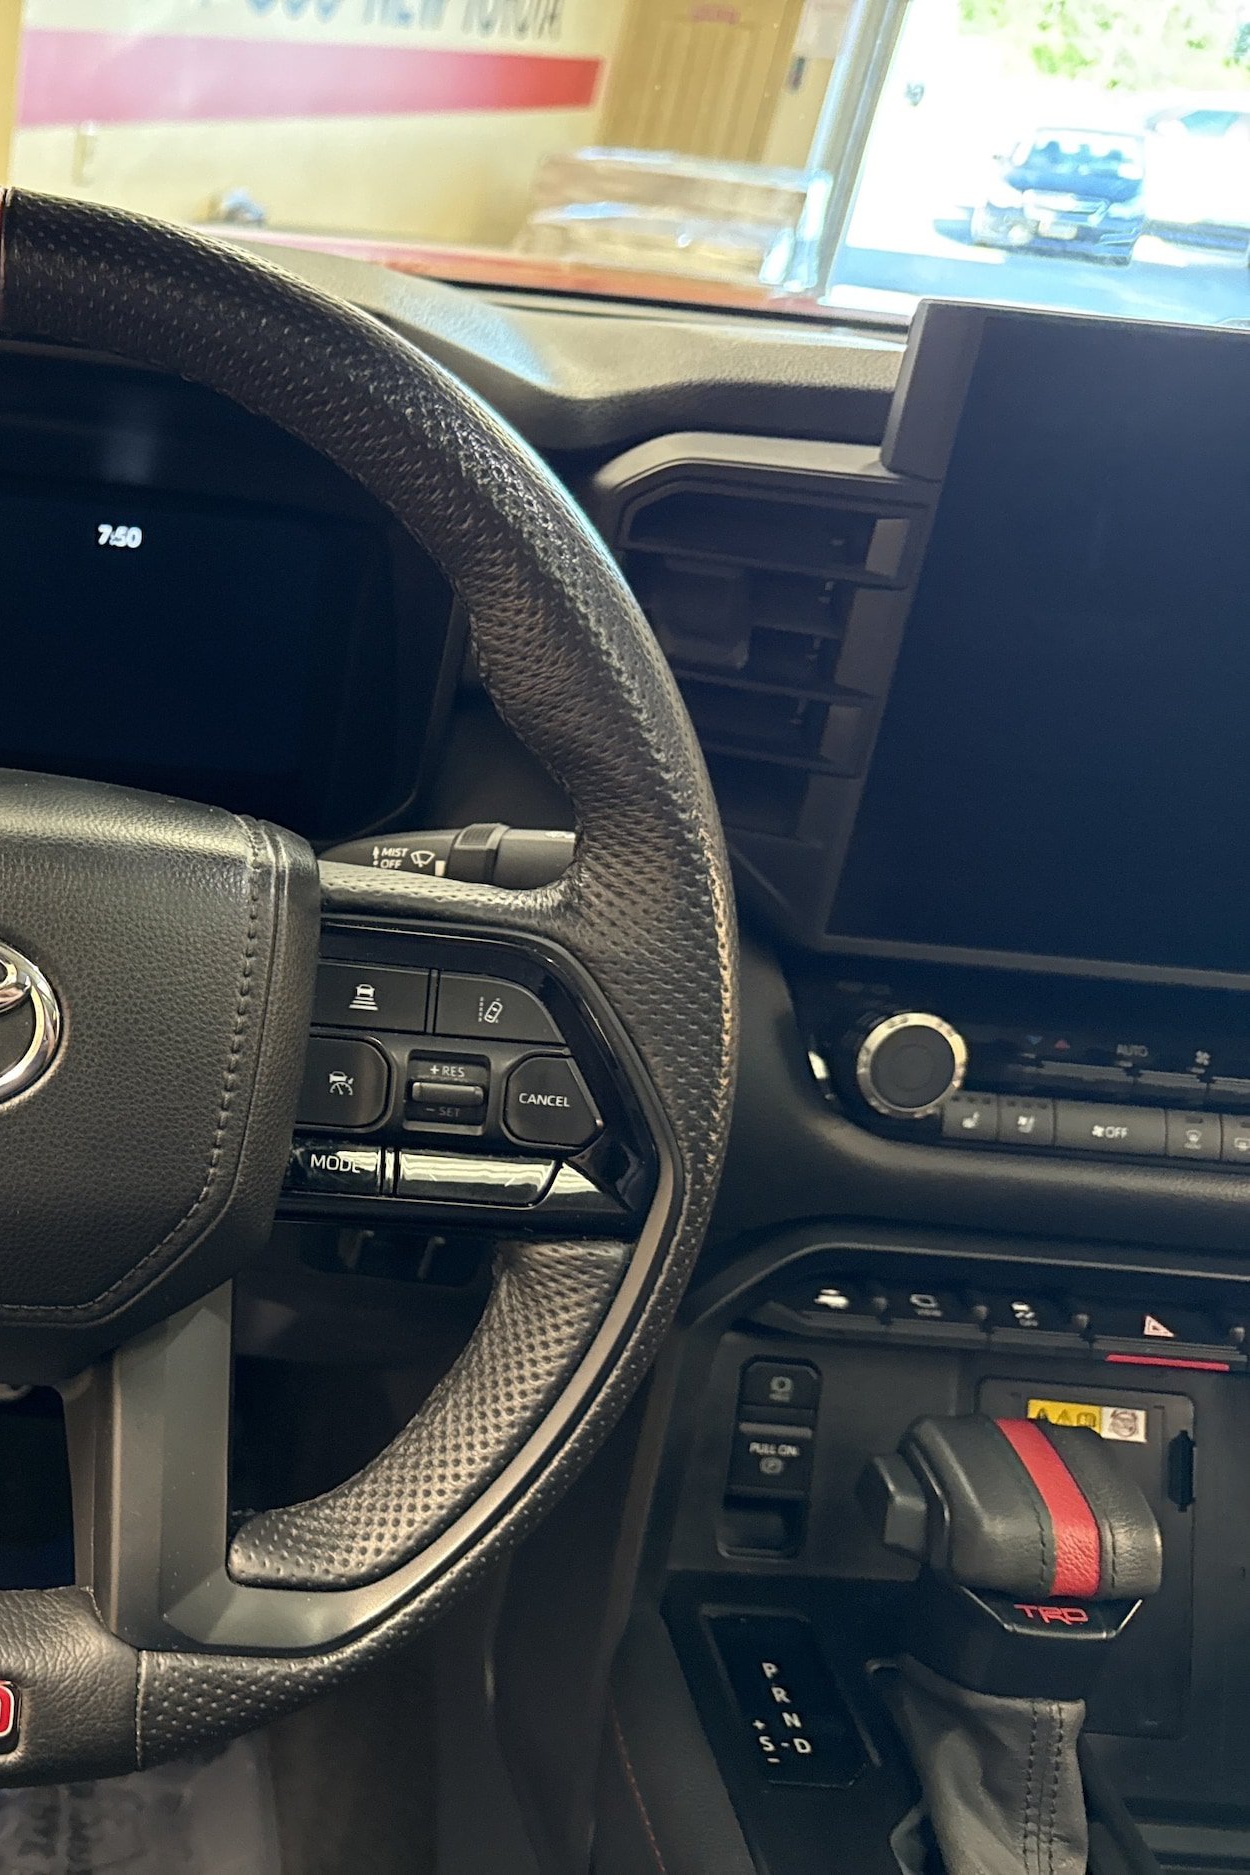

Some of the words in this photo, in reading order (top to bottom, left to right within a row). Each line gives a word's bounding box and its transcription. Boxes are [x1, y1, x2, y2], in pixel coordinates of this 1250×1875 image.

[97, 523, 143, 549] 7:50
[381, 847, 409, 858] MIST
[380, 859, 402, 869] OFF
[518, 1092, 570, 1108] CANCEL
[1105, 1126, 1128, 1139] OFF
[1013, 1603, 1089, 1625] TRD
[761, 1662, 778, 1679] P
[771, 1687, 791, 1703] R
[782, 1712, 802, 1728] N
